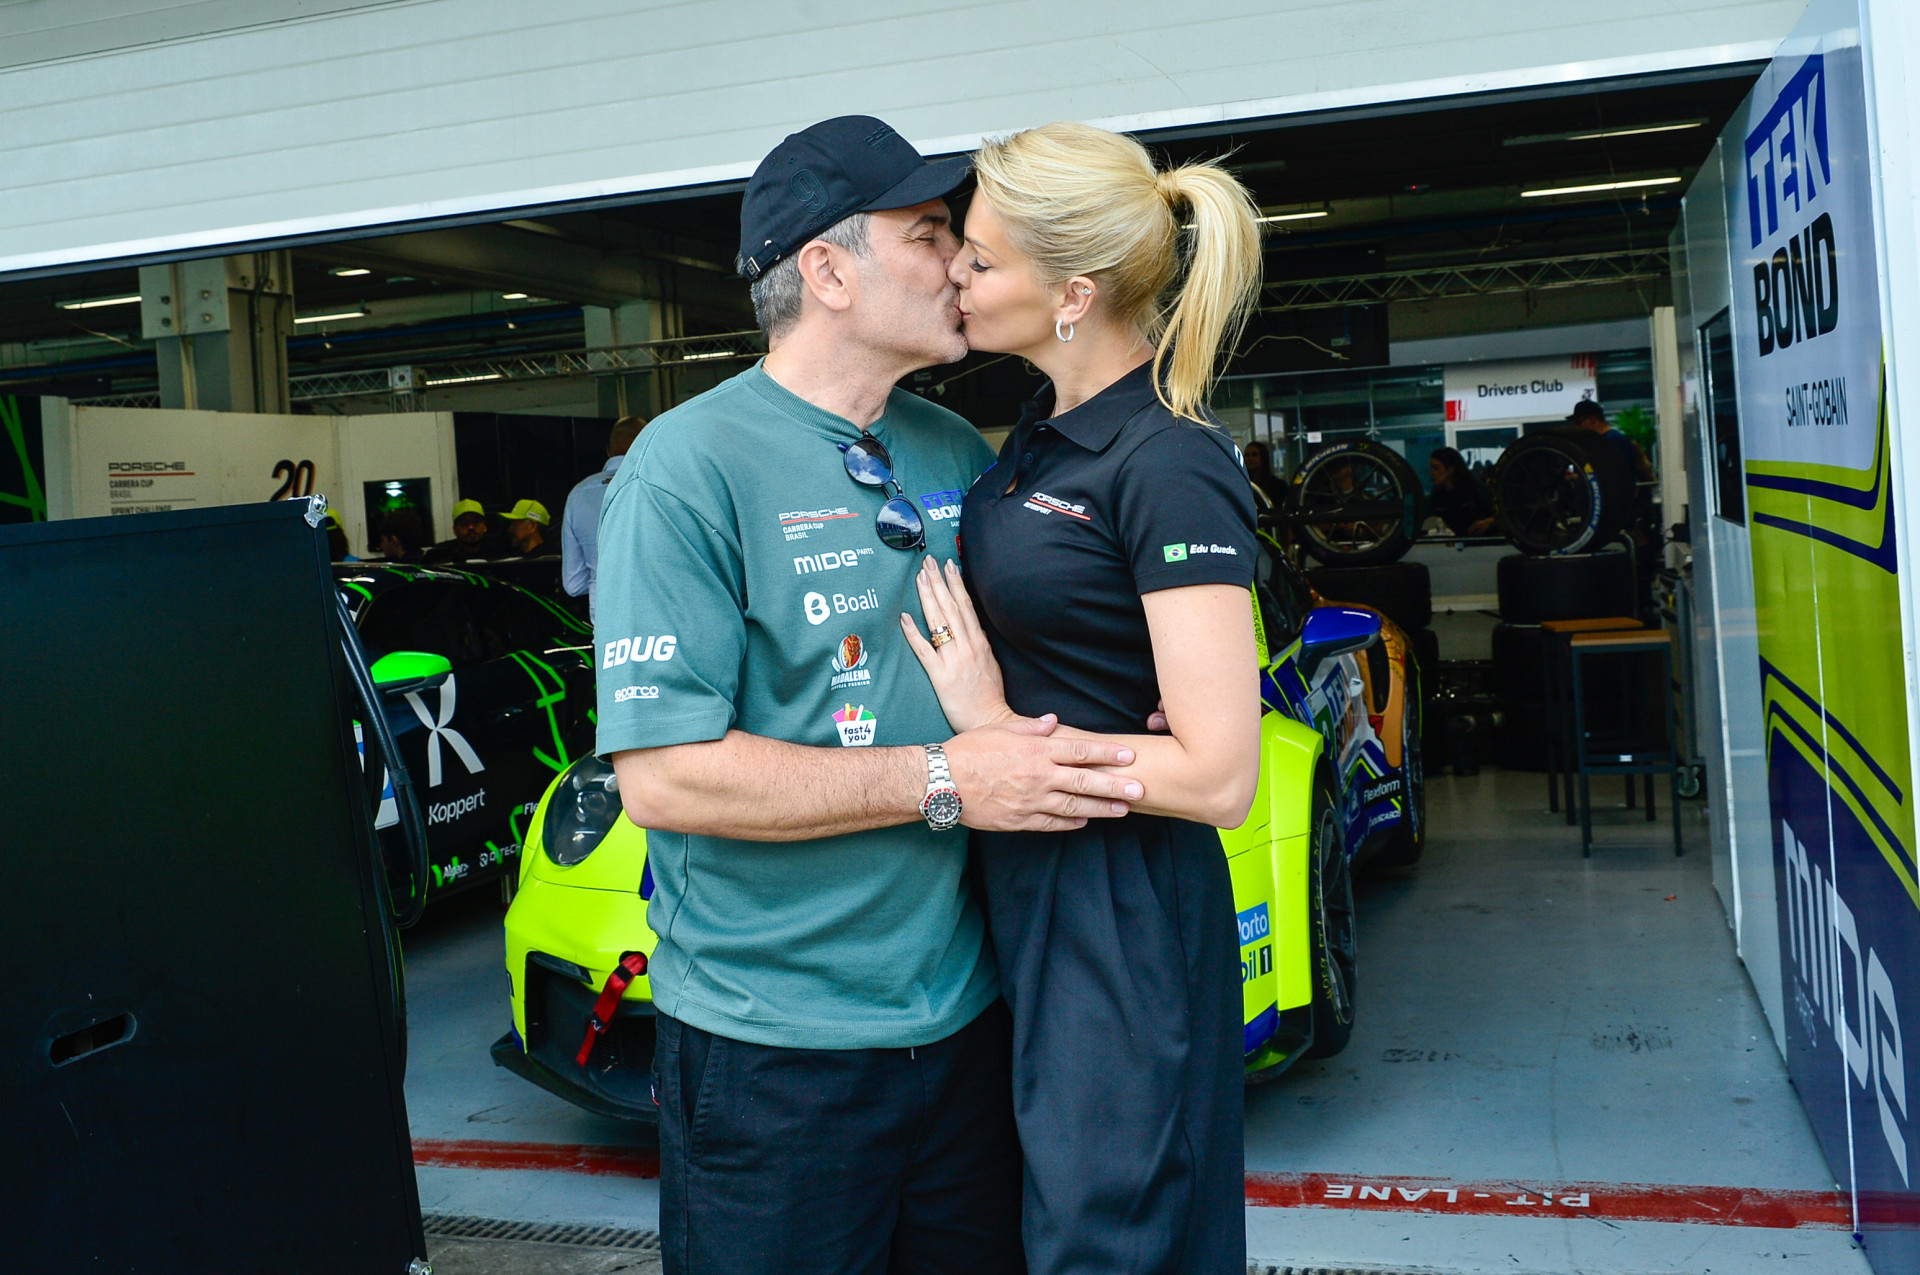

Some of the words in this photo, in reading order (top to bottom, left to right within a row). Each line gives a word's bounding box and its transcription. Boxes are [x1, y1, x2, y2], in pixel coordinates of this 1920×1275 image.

[1746, 55, 1831, 249] TEK
[790, 168, 829, 214] 9
[1753, 212, 1839, 357] BOND
[1477, 383, 1528, 398] Drivers
[1531, 379, 1564, 394] Club
[1786, 376, 1849, 426] SAINT-GOBAIN
[108, 461, 186, 472] PORSCHE
[110, 480, 139, 489] CARRERA
[140, 479, 154, 488] CUP
[270, 459, 315, 501] 20
[927, 504, 962, 521] BON
[1032, 492, 1086, 514] PORSCHE
[778, 507, 850, 522] PORSCHE
[783, 523, 812, 534] CARRERA
[813, 522, 824, 530] CUP
[785, 532, 809, 541] BRASIL
[856, 547, 874, 556] PARTS
[1189, 543, 1209, 555] Edu
[833, 588, 879, 614] Boali
[602, 635, 677, 670] EDUG
[614, 685, 659, 702] sparco
[848, 734, 867, 743] you
[1363, 778, 1400, 803] Flexform
[428, 788, 486, 826] Koppert
[524, 801, 538, 815] Fle
[1262, 948, 1269, 972] 1
[1324, 1184, 1458, 1203] LANE
[1506, 1192, 1590, 1208] PIT
